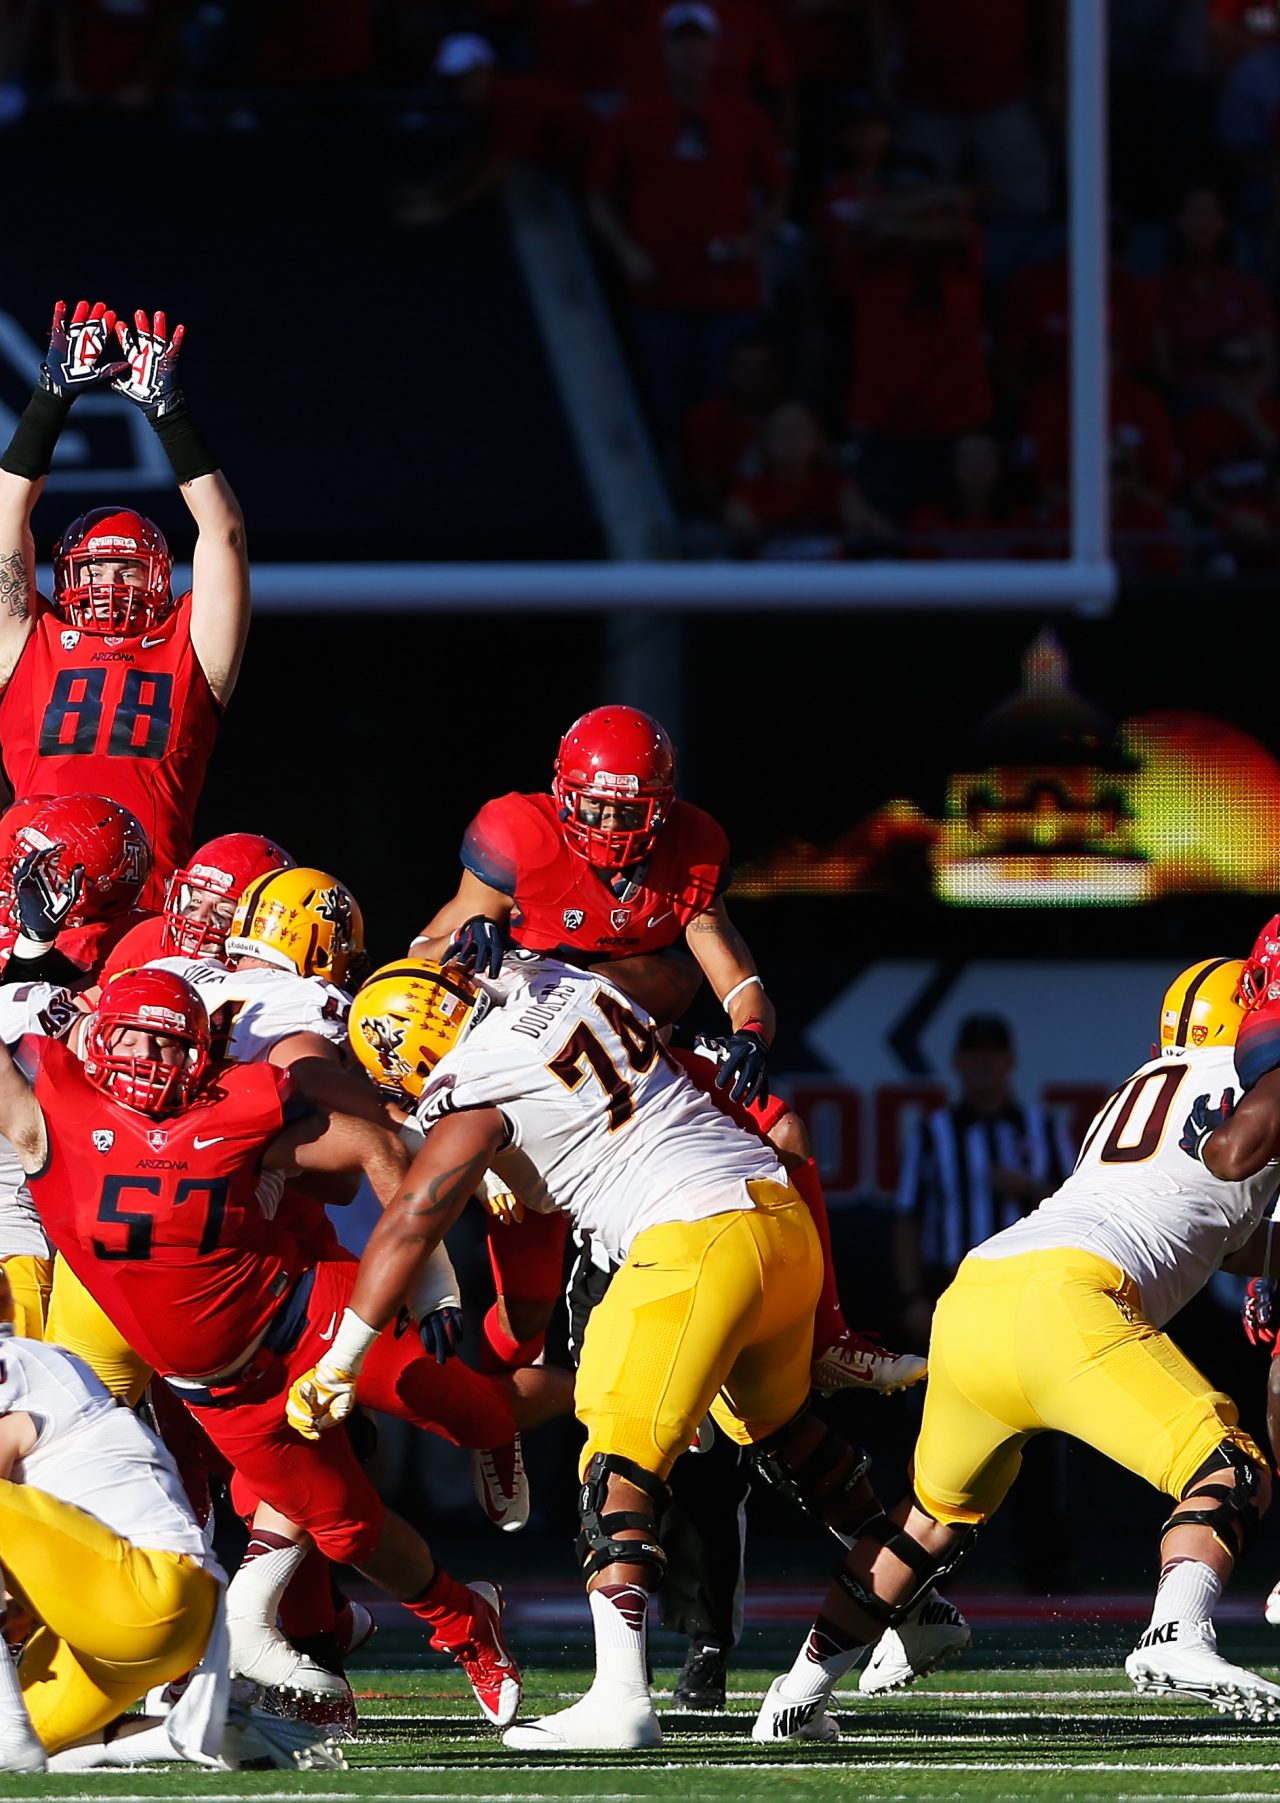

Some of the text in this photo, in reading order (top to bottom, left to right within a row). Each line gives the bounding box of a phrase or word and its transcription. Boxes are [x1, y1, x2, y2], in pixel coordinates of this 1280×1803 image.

[90, 652, 135, 663] ARIZONA
[38, 668, 177, 761] 88
[565, 918, 578, 929] 12
[37, 988, 81, 1038] ASU
[511, 983, 576, 1040] DOUGLAS
[544, 987, 680, 1136] 74
[92, 1130, 114, 1142] PAC
[1073, 1063, 1191, 1174] 0
[97, 1140, 111, 1151] 12
[135, 1158, 189, 1171] ARIZONA
[93, 1174, 229, 1261] 57
[773, 1699, 822, 1738] NIKE
